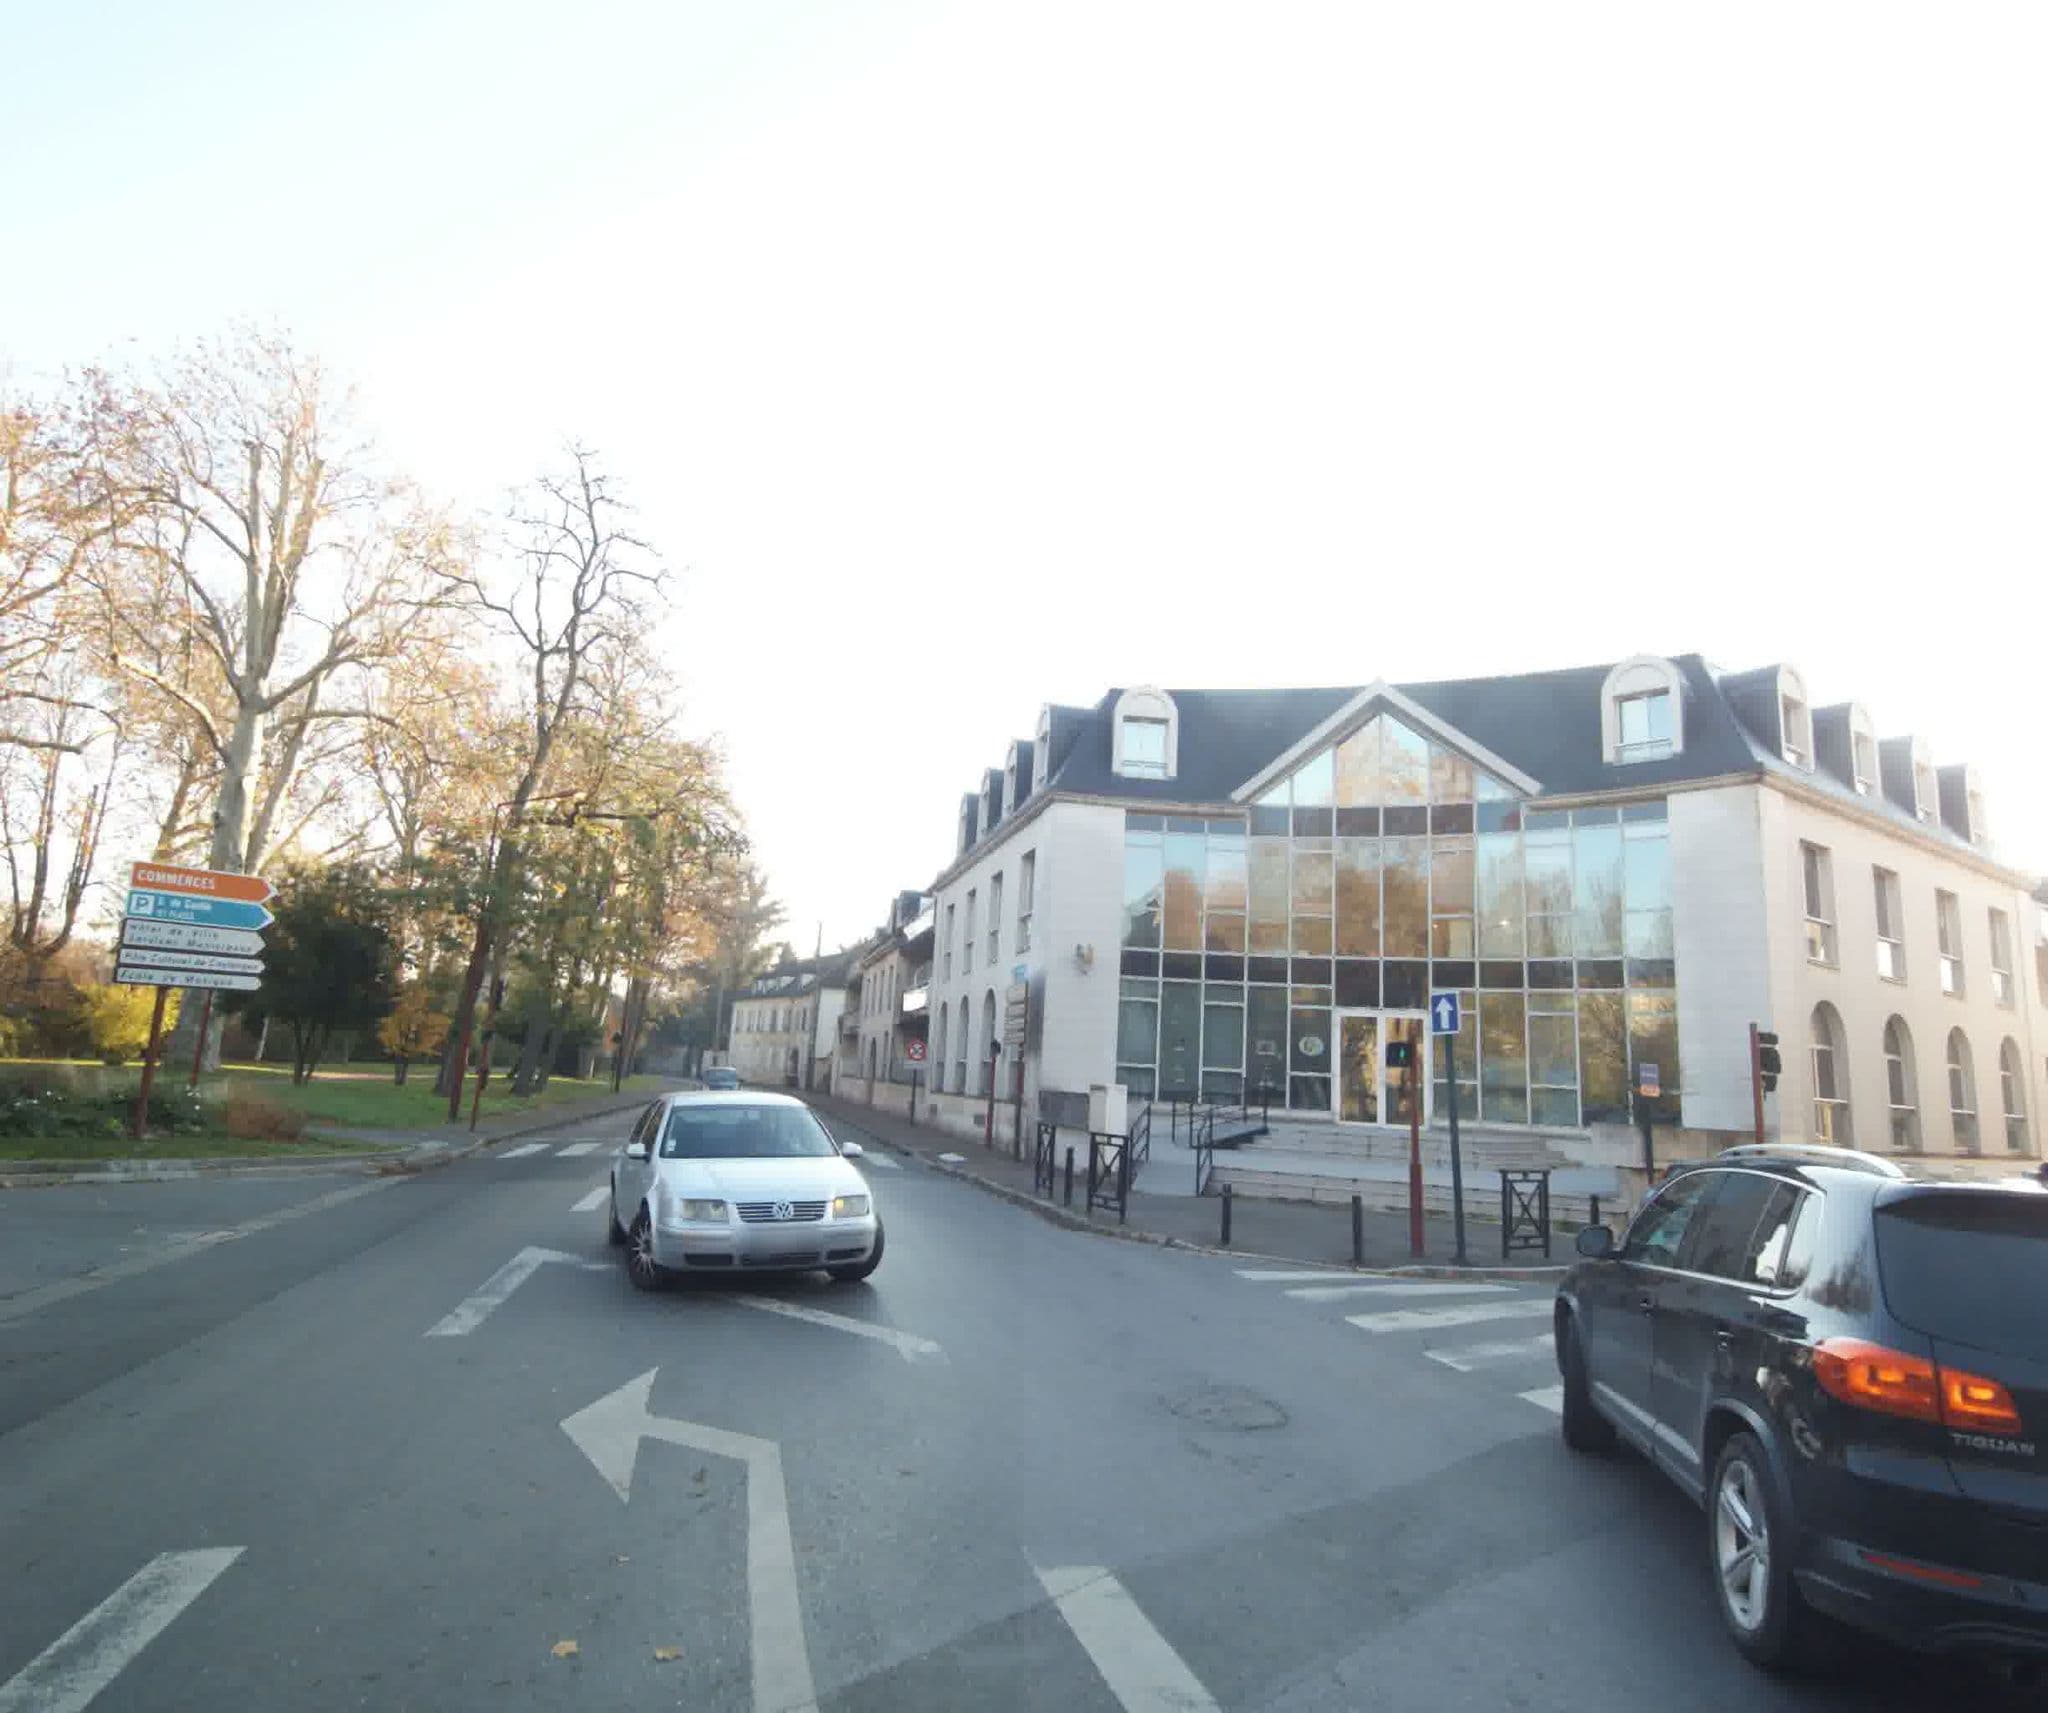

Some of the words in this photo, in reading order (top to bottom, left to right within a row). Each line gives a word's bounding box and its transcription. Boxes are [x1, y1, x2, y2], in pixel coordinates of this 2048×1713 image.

[138, 869, 215, 890] COMMERCES
[135, 896, 149, 911] P
[1951, 1432, 2036, 1456] TIGUAN
